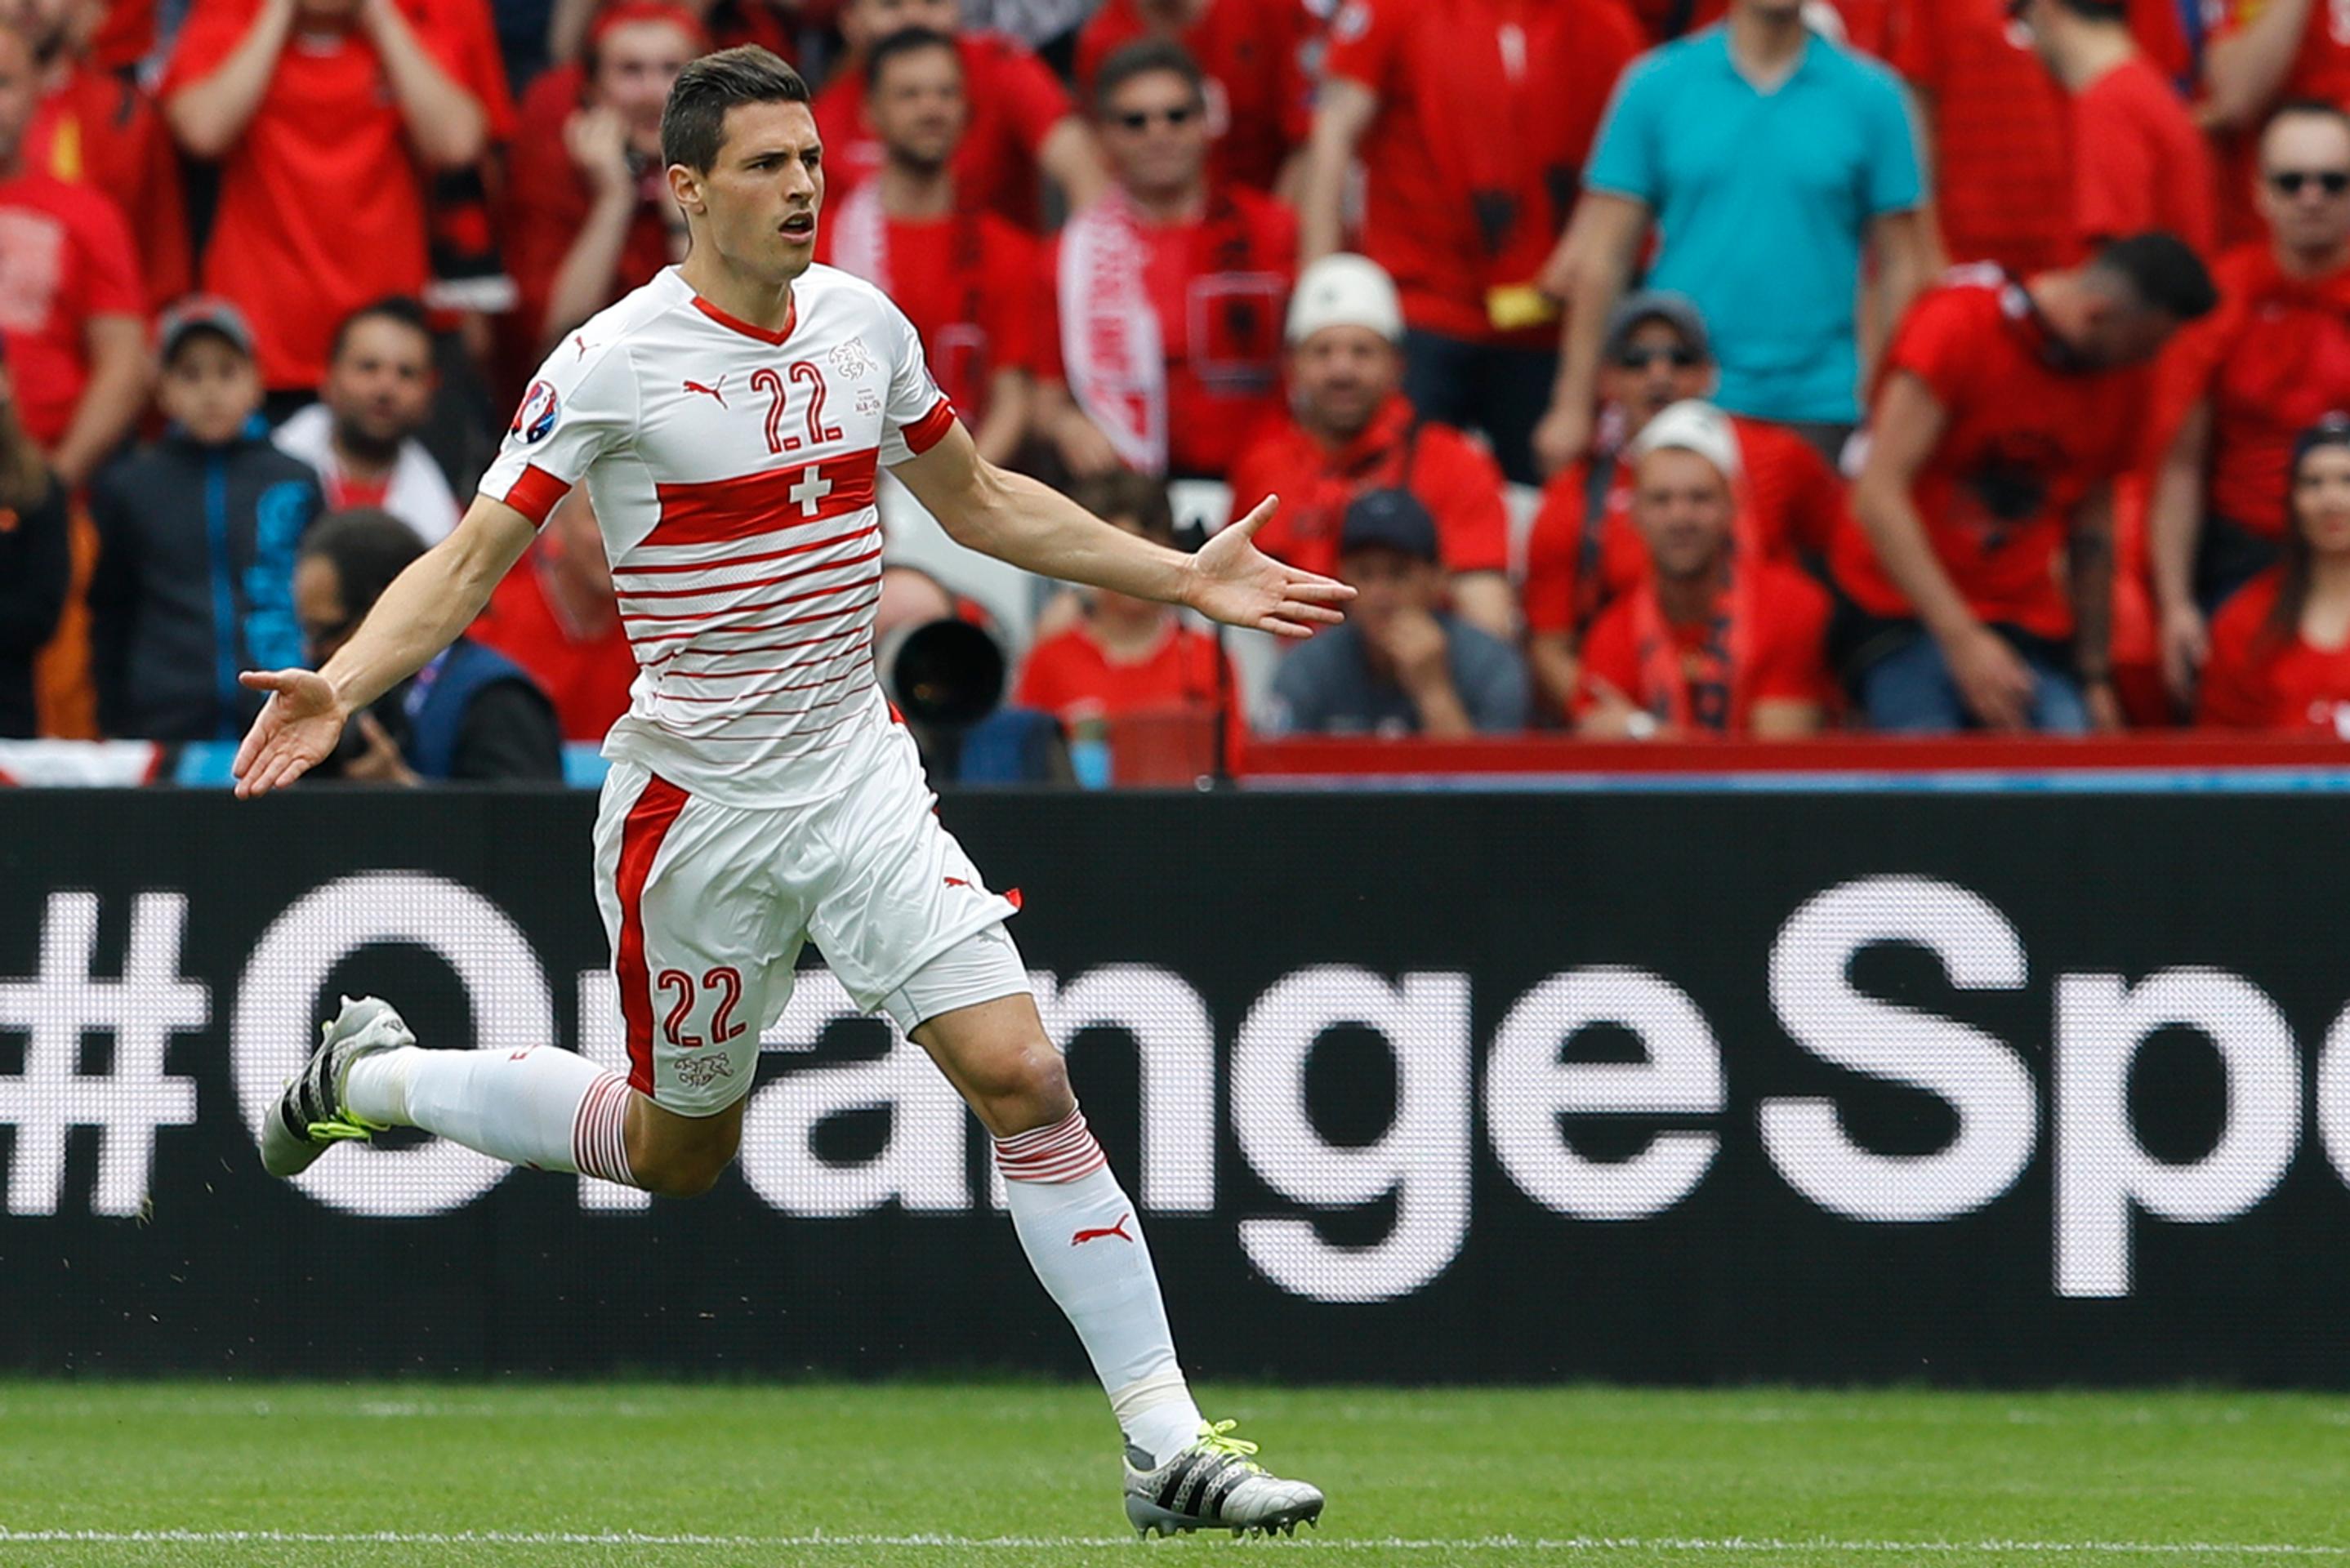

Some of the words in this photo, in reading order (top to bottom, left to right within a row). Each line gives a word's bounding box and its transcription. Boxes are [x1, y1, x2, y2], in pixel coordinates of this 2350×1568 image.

[750, 360, 843, 454] 22
[658, 966, 747, 1047] 22
[0, 868, 2350, 1303] #OangeSp
